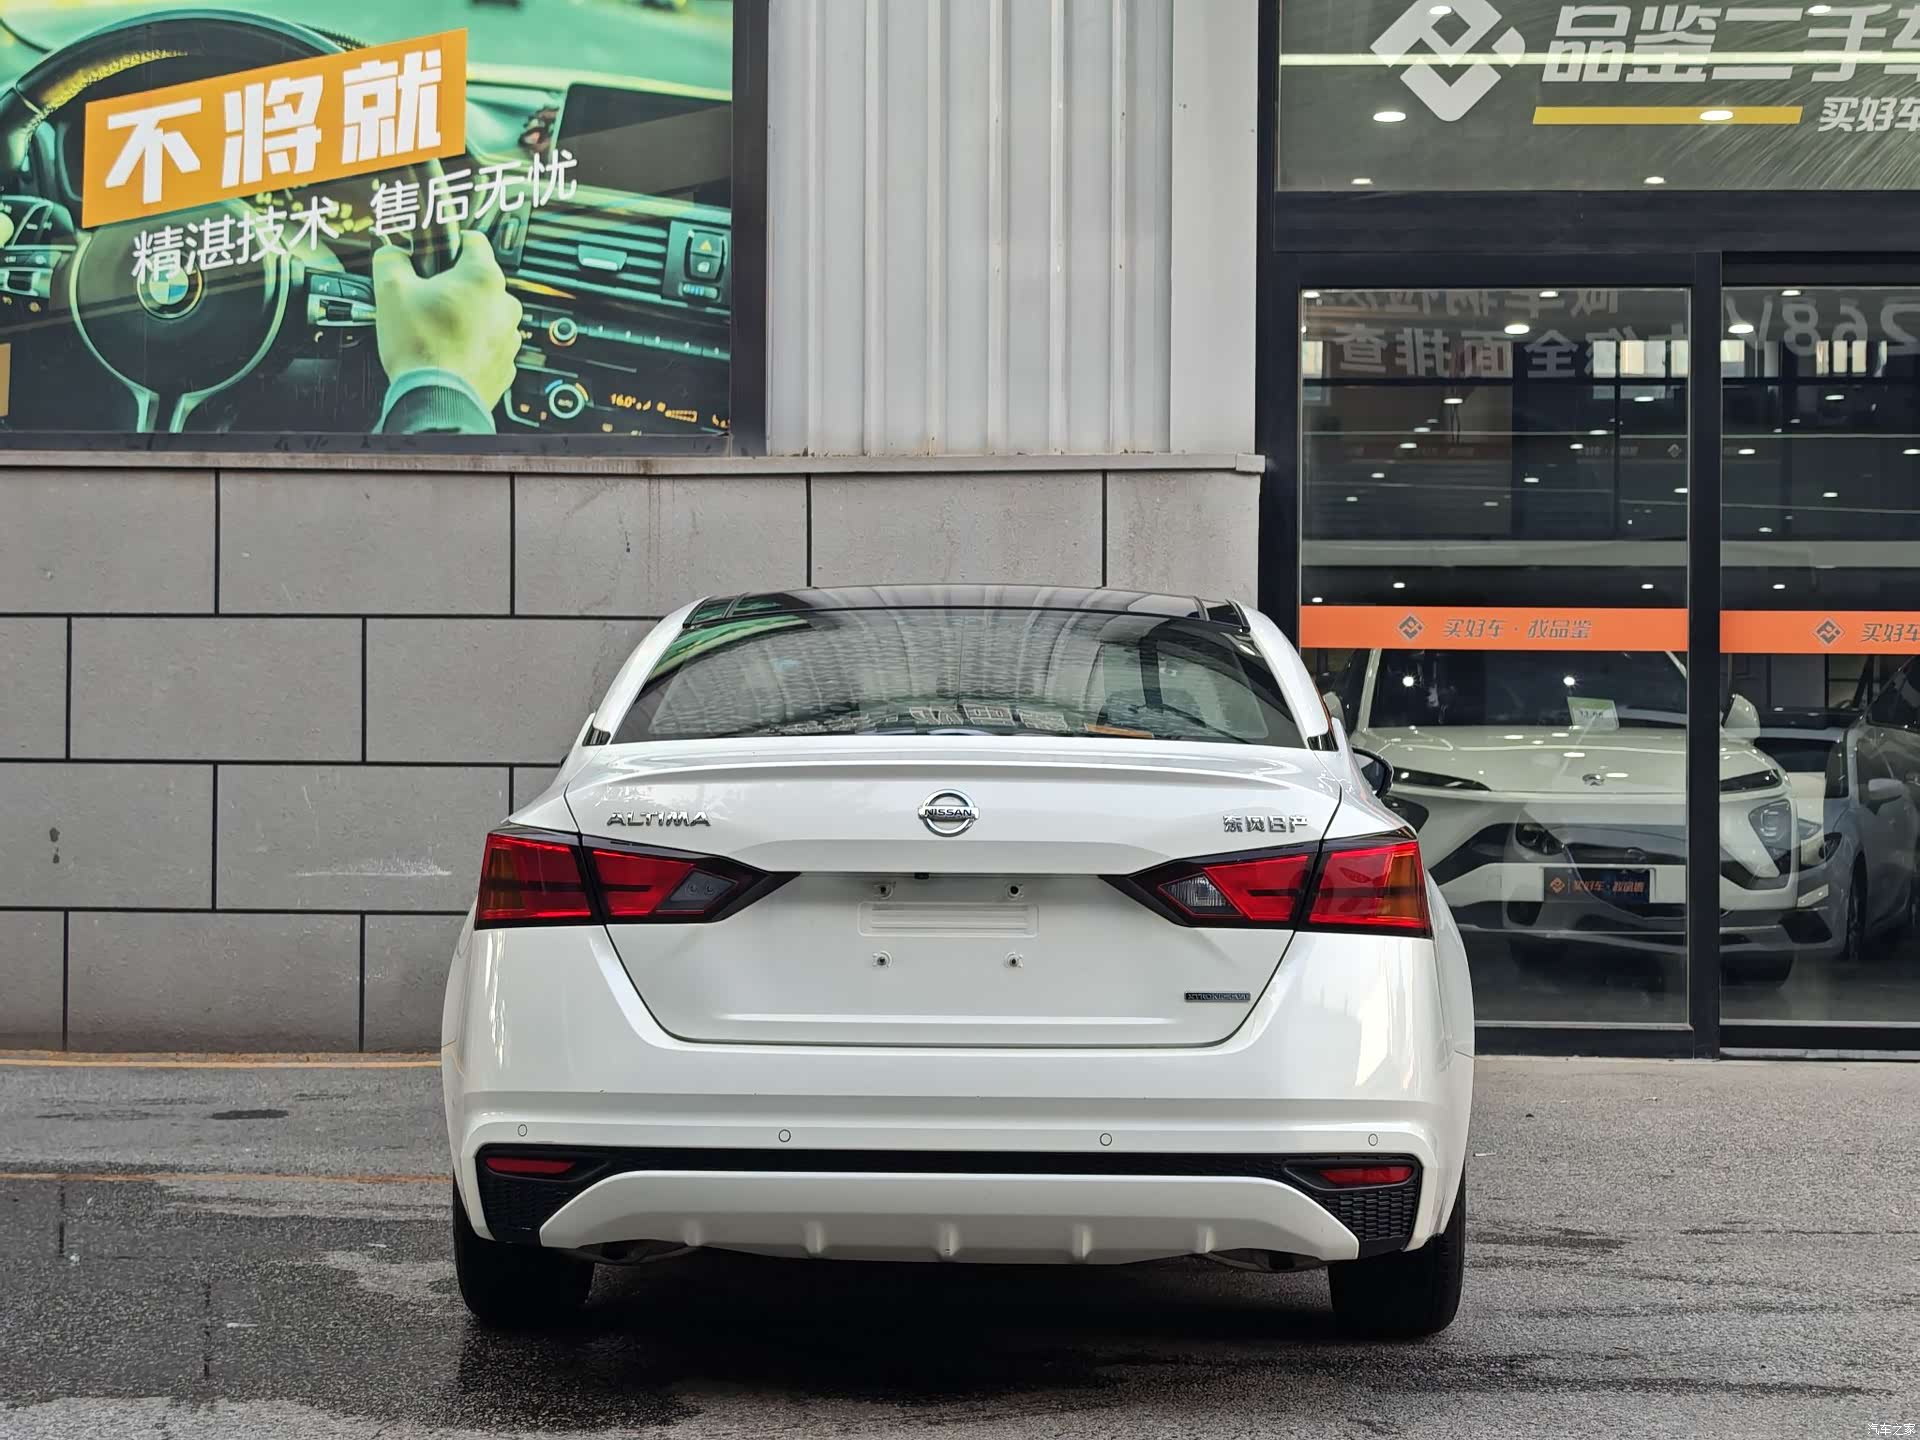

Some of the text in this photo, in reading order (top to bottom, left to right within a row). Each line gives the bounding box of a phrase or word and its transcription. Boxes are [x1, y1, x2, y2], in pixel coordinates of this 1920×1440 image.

[105, 49, 442, 204] 不将就
[131, 149, 578, 280] 精湛技术 售后无忧
[607, 811, 711, 826] ALTIMA
[924, 808, 972, 817] NISSAN
[1223, 815, 1308, 833] 东风日产
